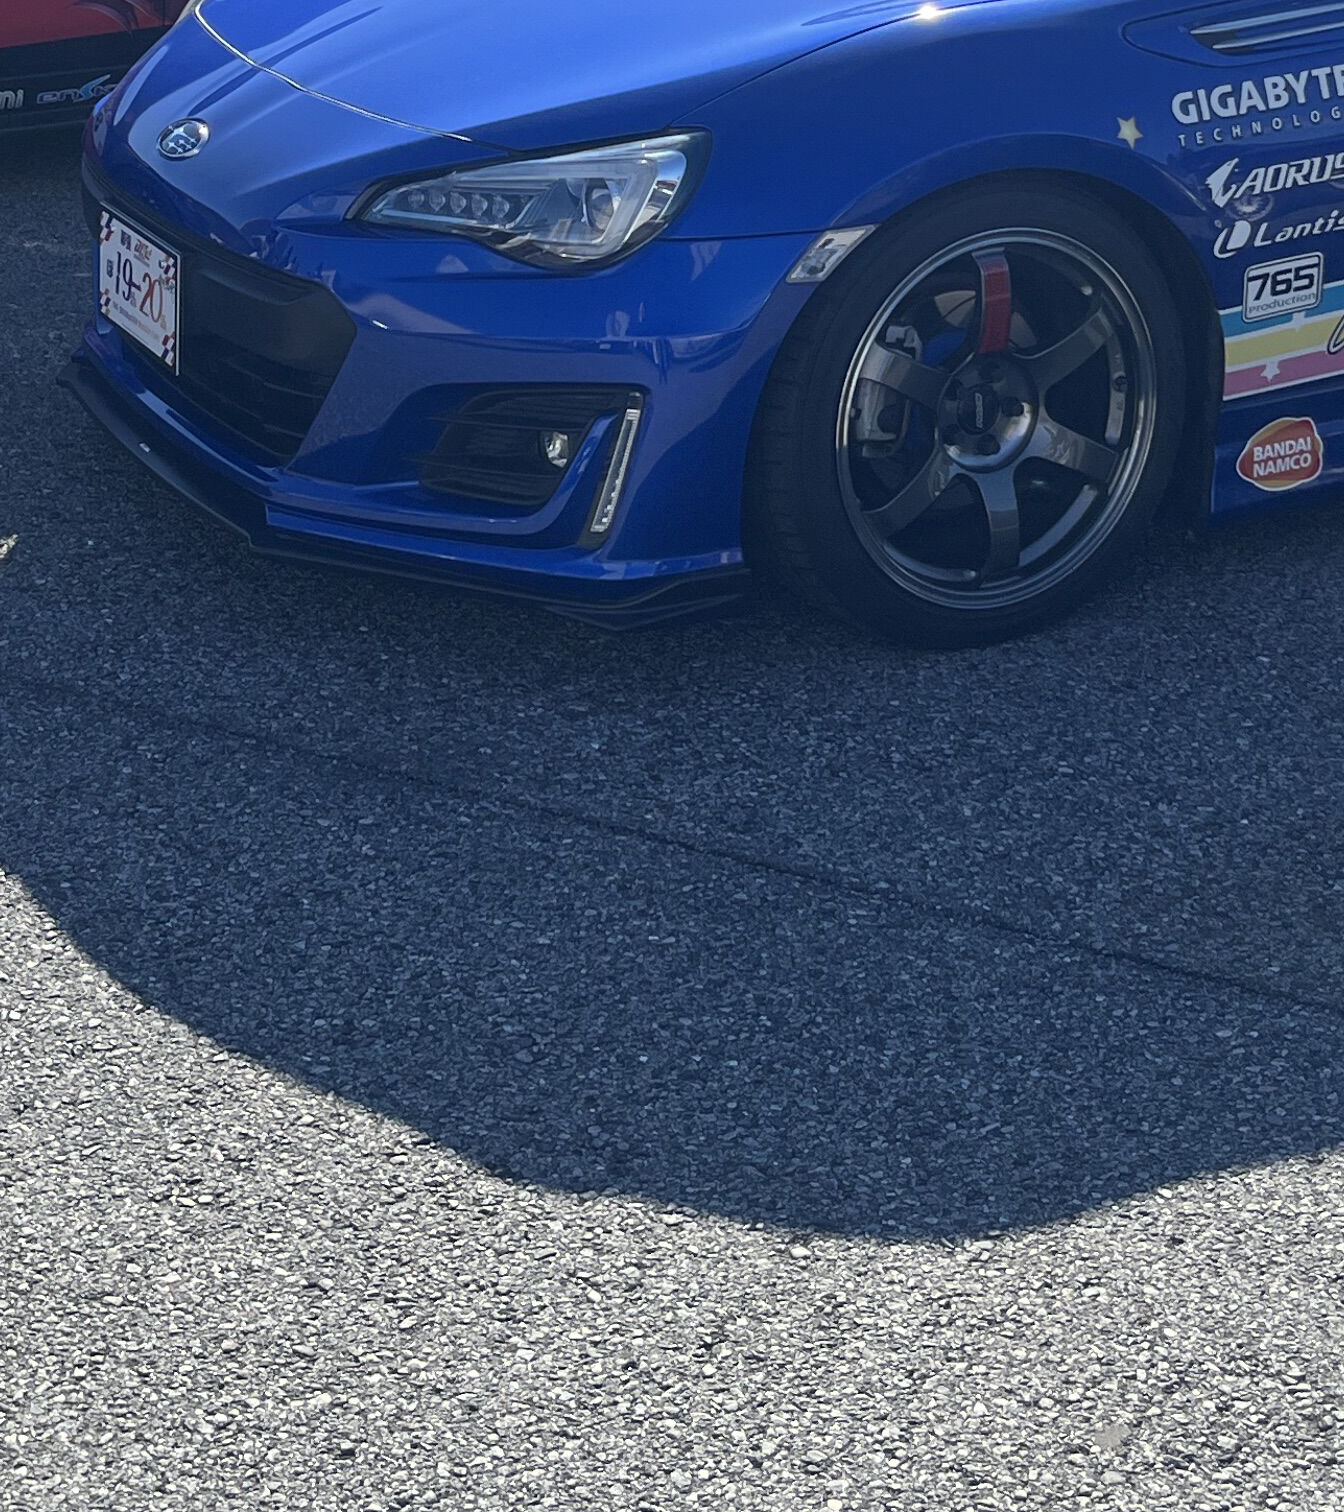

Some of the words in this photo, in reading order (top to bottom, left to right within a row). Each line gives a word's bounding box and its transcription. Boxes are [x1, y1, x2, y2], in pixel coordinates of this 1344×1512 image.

[1247, 263, 1319, 302] 765
[1253, 436, 1312, 462] BANDAI
[1253, 452, 1312, 478] NAMCO
